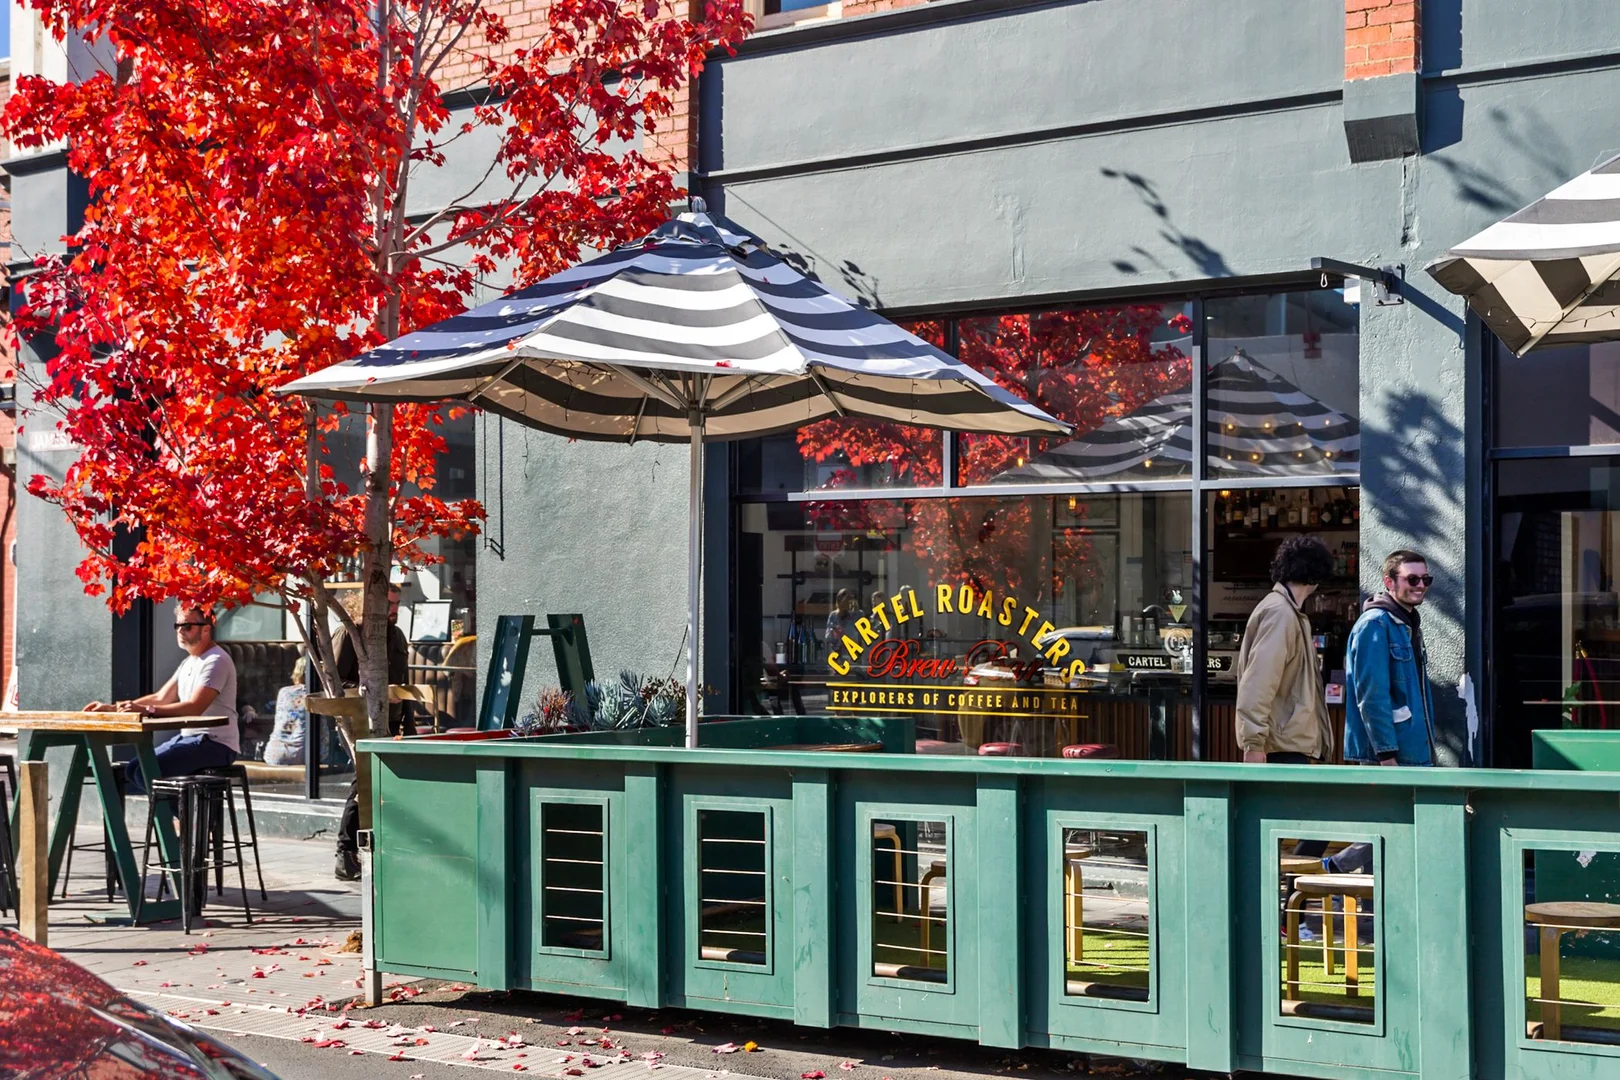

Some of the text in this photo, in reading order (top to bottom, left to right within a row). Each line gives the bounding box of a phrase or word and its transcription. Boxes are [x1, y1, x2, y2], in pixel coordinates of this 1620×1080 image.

[827, 583, 1086, 684] CARTEL ROASTERS
[867, 638, 1046, 682] Brew Bar
[1128, 656, 1167, 667] CARTEL
[833, 691, 1078, 710] EXPLORERS OF COFFEE AND TEA
